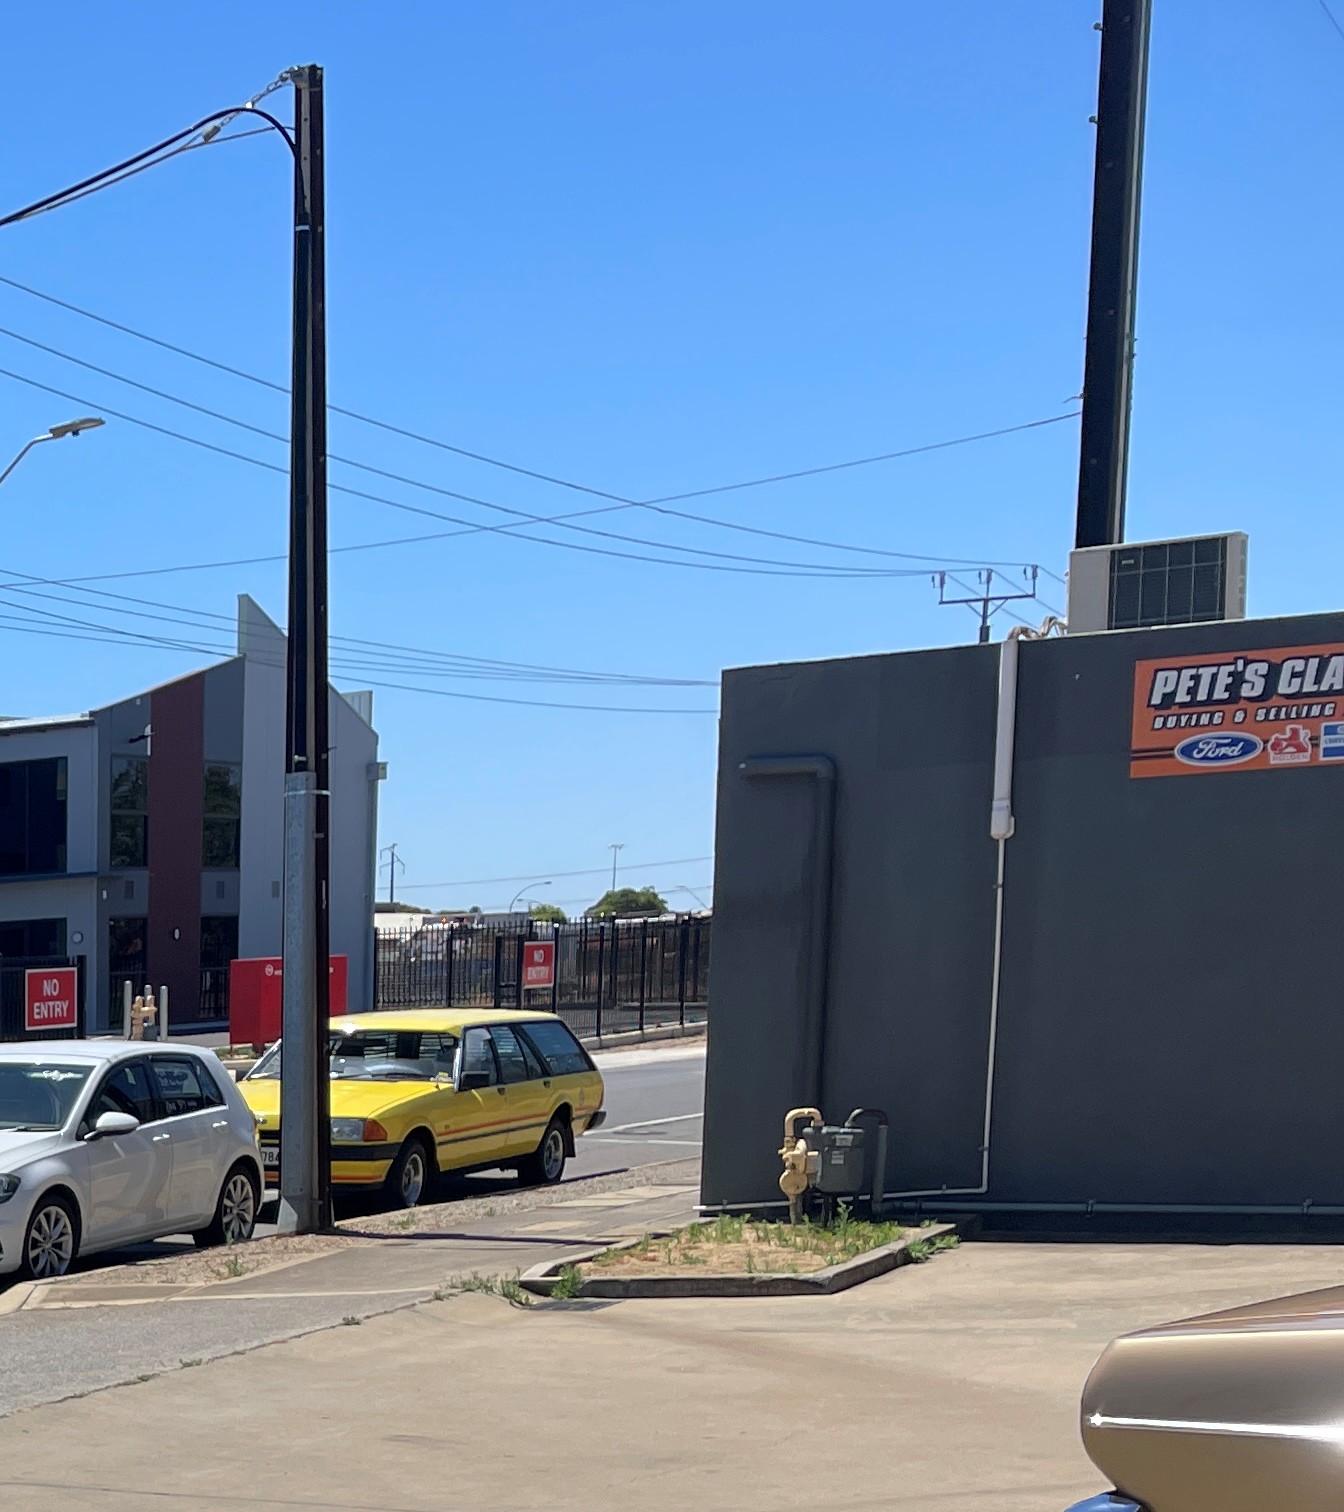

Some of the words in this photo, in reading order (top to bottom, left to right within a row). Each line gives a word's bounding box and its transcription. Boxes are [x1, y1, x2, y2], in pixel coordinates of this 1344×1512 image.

[1150, 658, 1270, 706] PETE'S
[1153, 710, 1224, 730] BUYING
[1255, 702, 1336, 721] SELLING
[1193, 738, 1245, 759] Ford
[43, 978, 60, 997] NO
[33, 1000, 70, 1020] ENTRY
